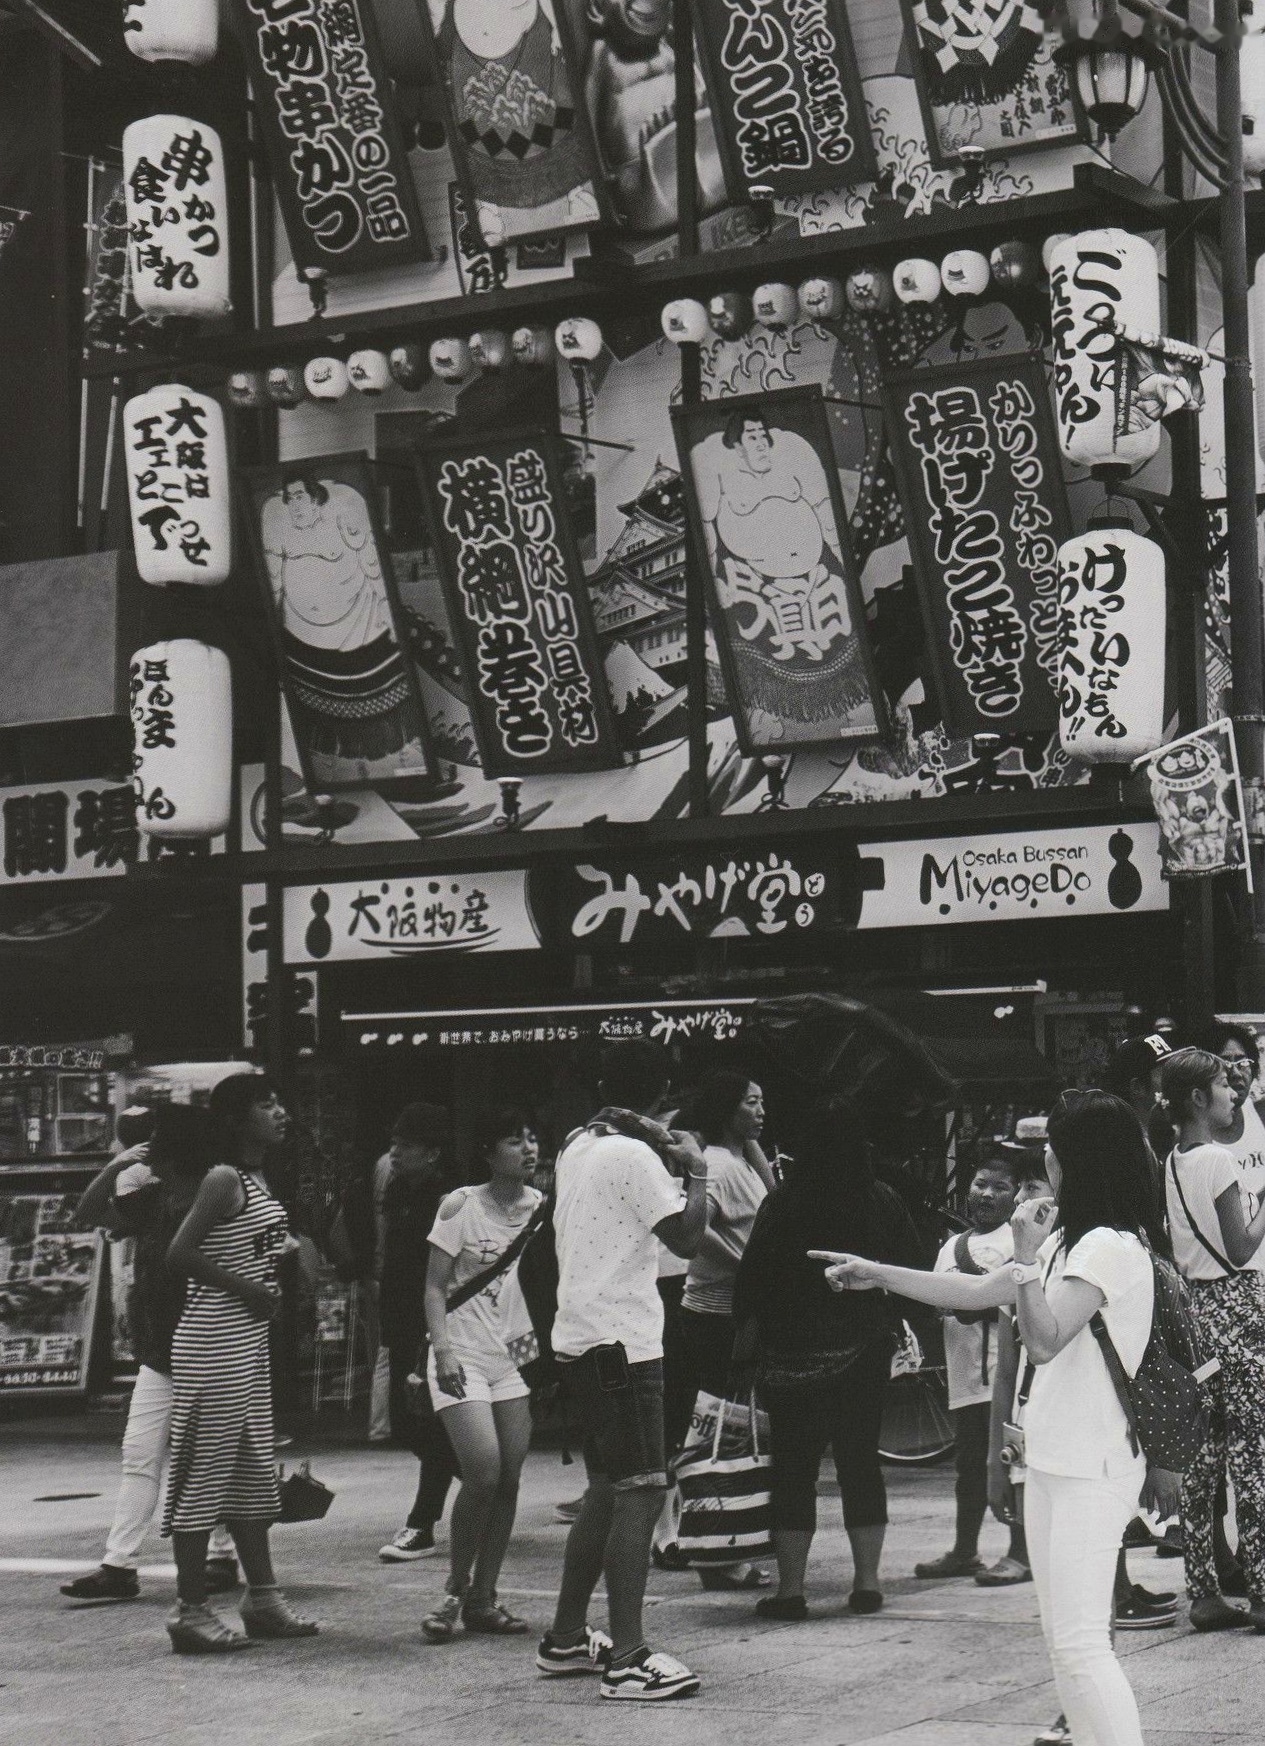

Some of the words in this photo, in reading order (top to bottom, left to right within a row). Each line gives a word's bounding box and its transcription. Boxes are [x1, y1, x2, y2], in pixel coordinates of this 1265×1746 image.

[162, 130, 219, 257] 串かつ
[905, 386, 1027, 717] 揚げたこ焼き
[1080, 543, 1130, 739] けったいなもん
[348, 888, 490, 939] 大阪物産
[571, 852, 802, 944] みやげ堂
[919, 852, 1091, 906] MiyageDo
[962, 849, 1017, 868] Osaka
[1023, 843, 1088, 863] Bussan
